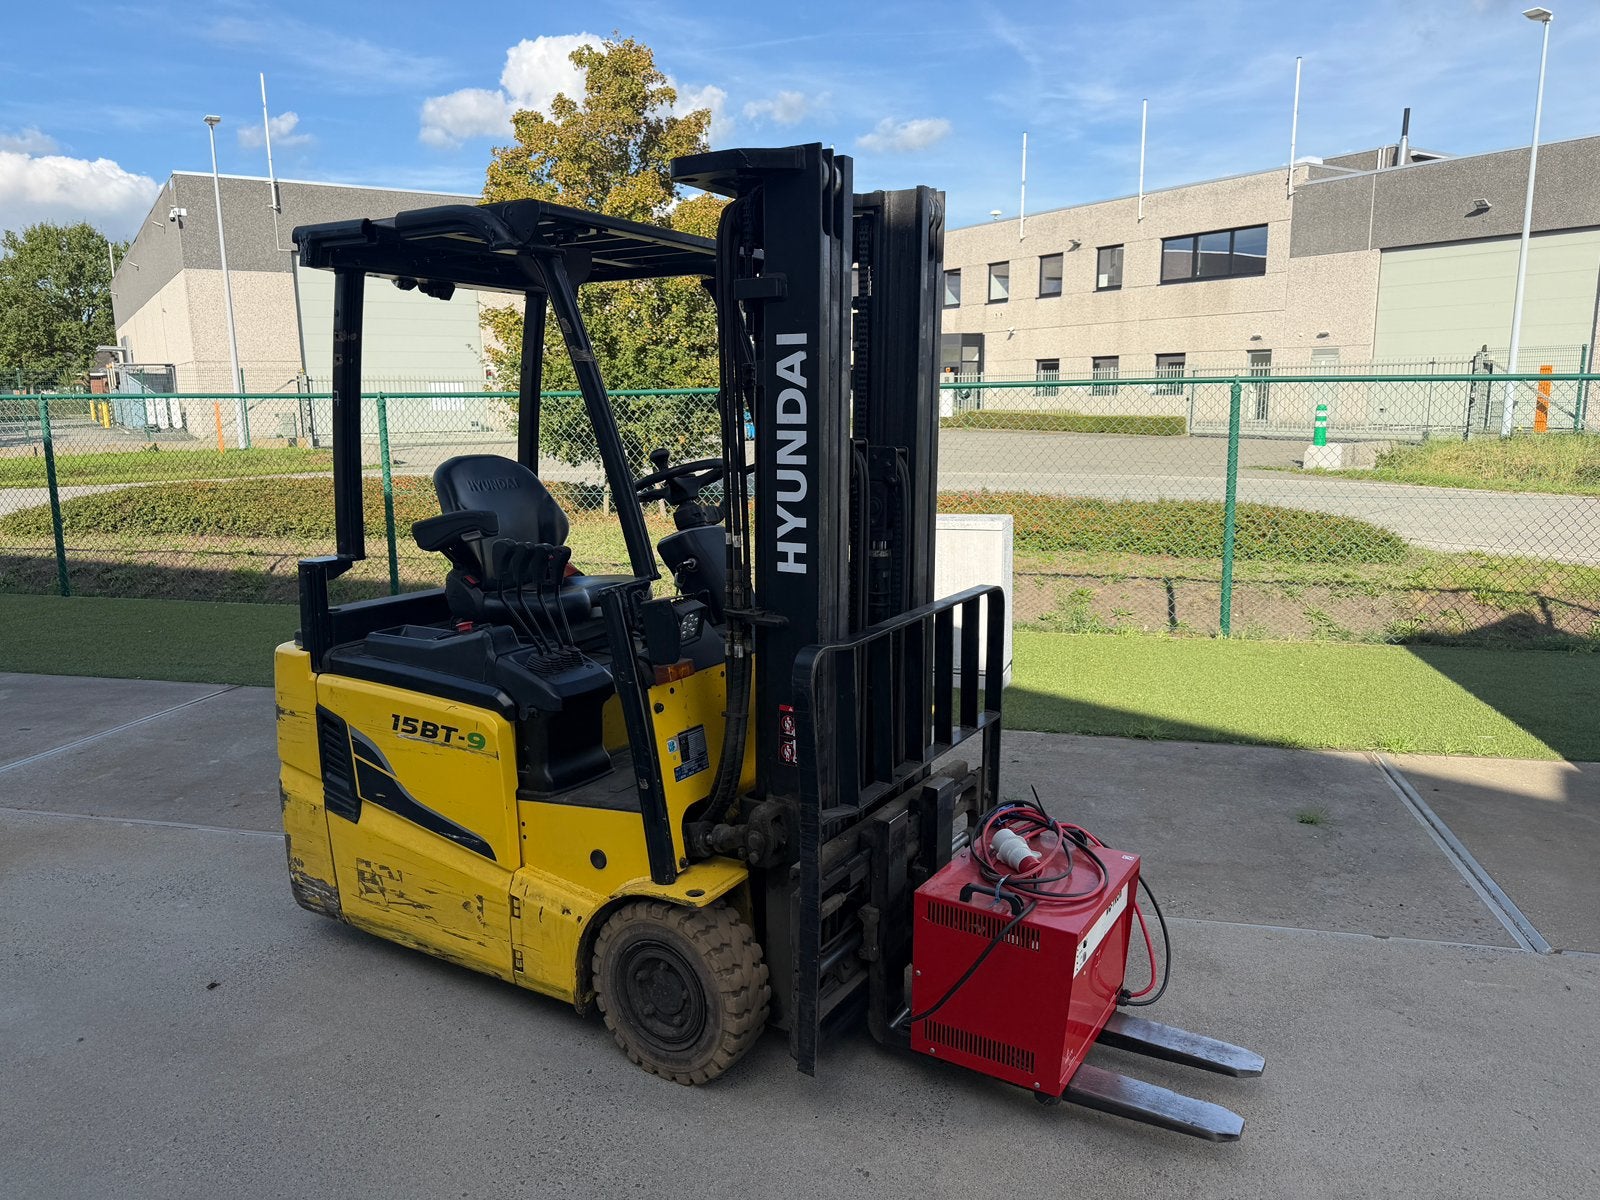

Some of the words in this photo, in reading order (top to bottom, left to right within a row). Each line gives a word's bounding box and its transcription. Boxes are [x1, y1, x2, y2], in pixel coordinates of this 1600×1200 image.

[776, 333, 808, 574] HYUNDAI
[467, 477, 521, 493] HYUNDAI
[391, 713, 486, 750] 15BT-9
